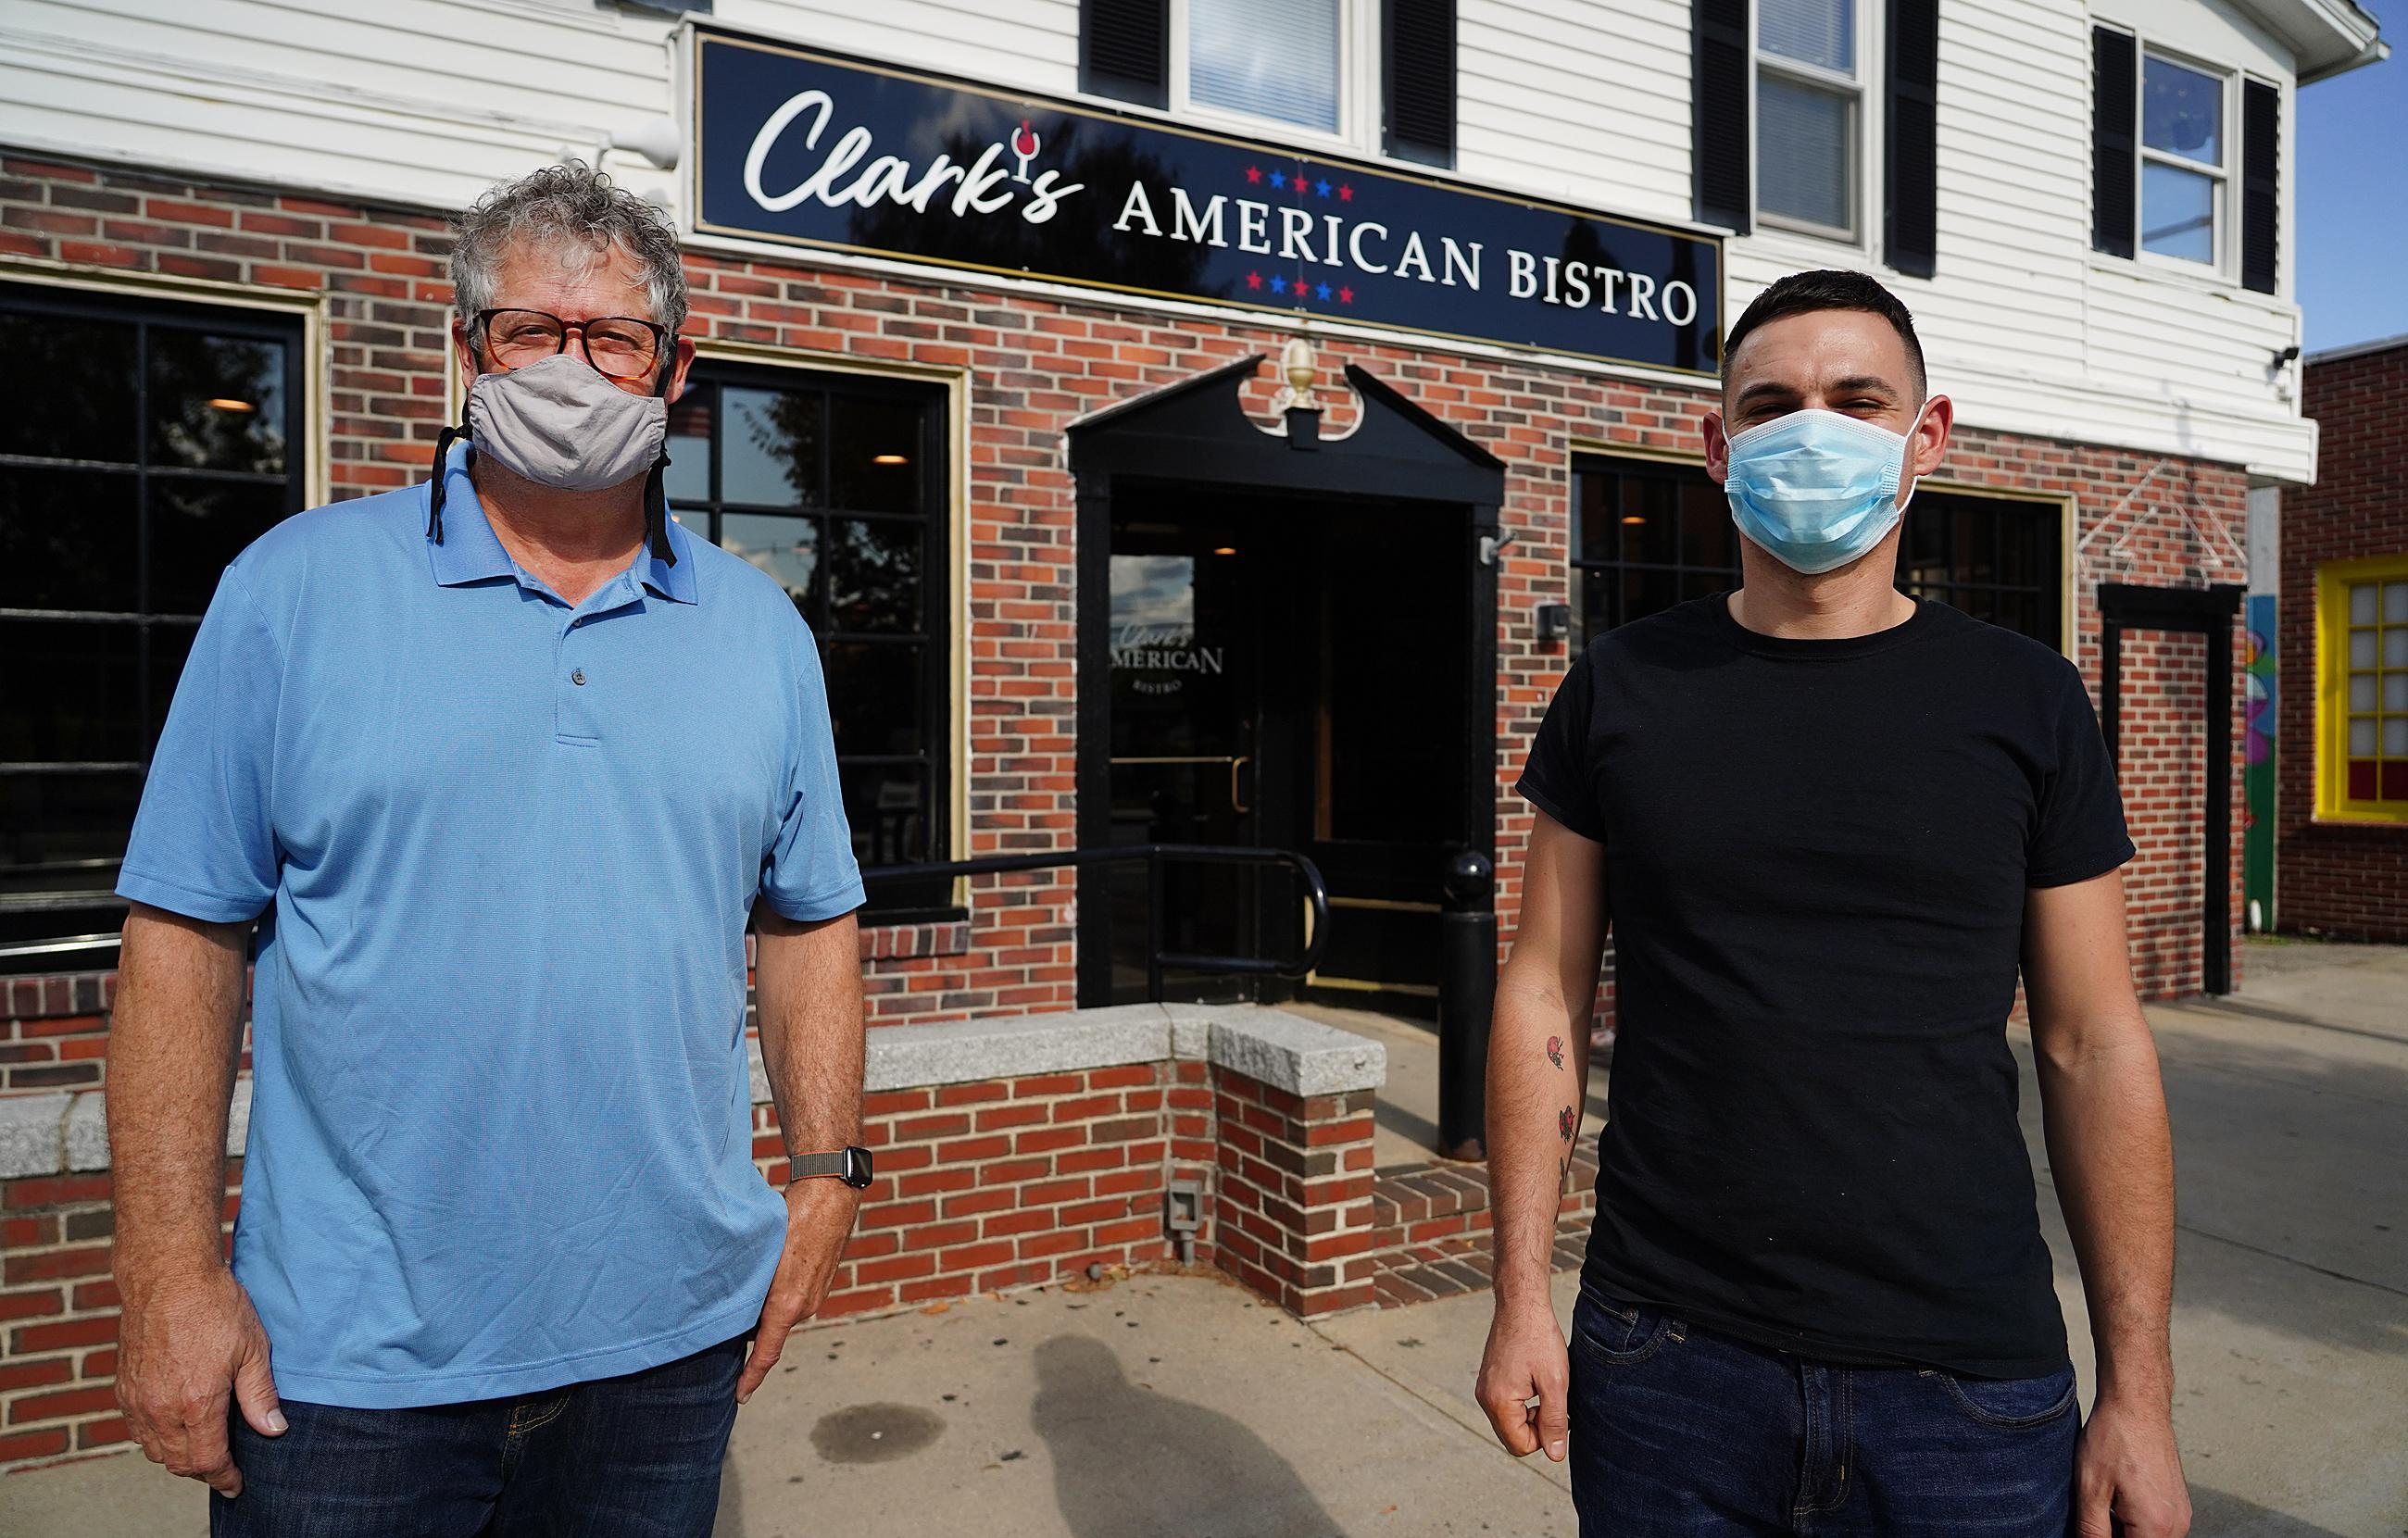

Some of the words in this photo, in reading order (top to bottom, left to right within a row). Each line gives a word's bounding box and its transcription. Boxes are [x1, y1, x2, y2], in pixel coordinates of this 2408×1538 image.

[744, 90, 1085, 225] Clark's
[1112, 180, 1484, 291] AMERICAN
[1507, 249, 1698, 327] BISTRO
[1109, 646, 1224, 675] MERICAN
